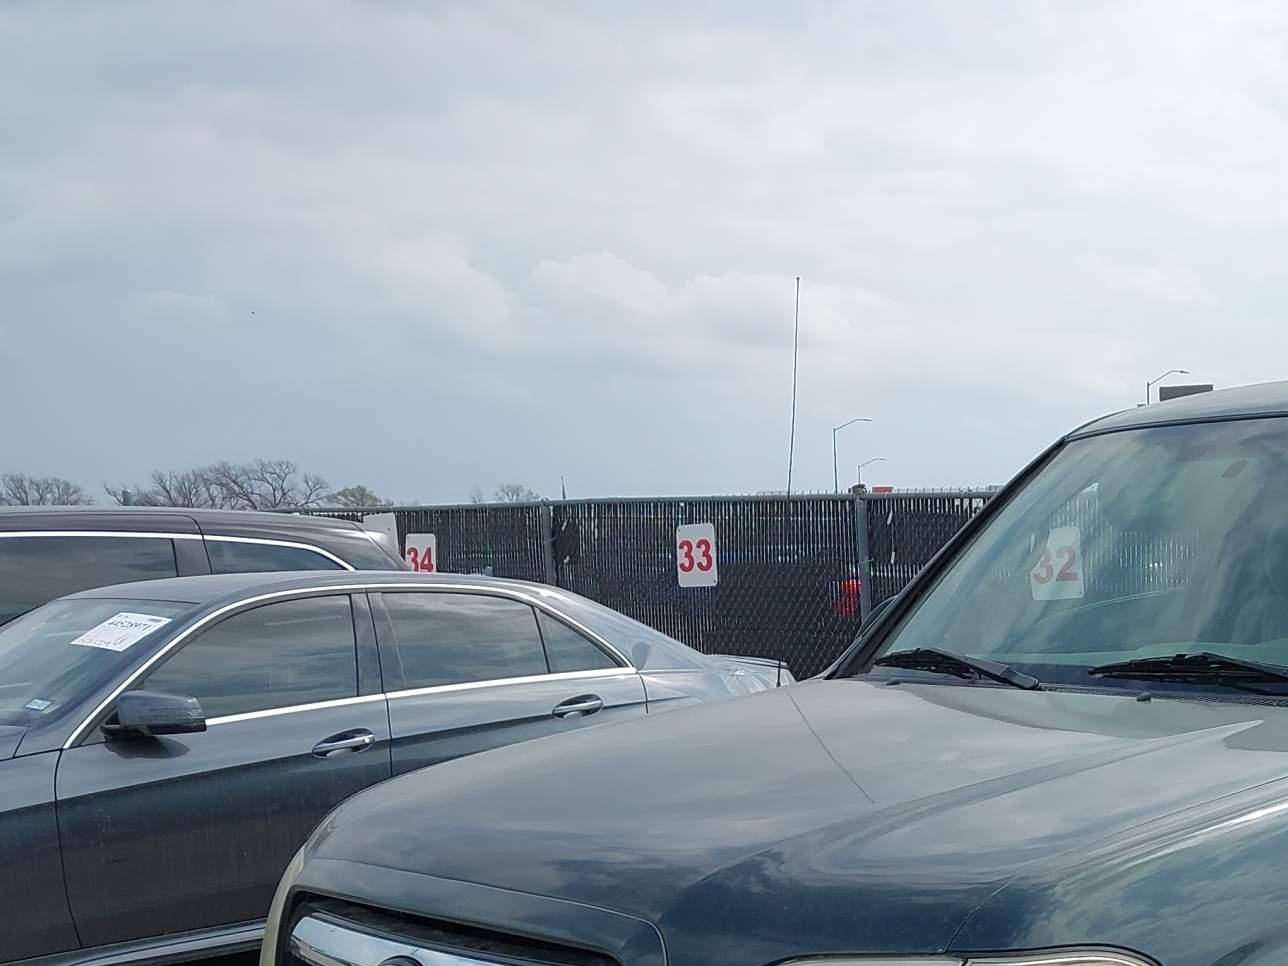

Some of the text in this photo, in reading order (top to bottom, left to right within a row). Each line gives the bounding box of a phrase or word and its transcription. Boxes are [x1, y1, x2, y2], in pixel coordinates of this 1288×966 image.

[407, 547, 434, 572] 34
[678, 538, 713, 573] 33
[1032, 545, 1079, 584] 32
